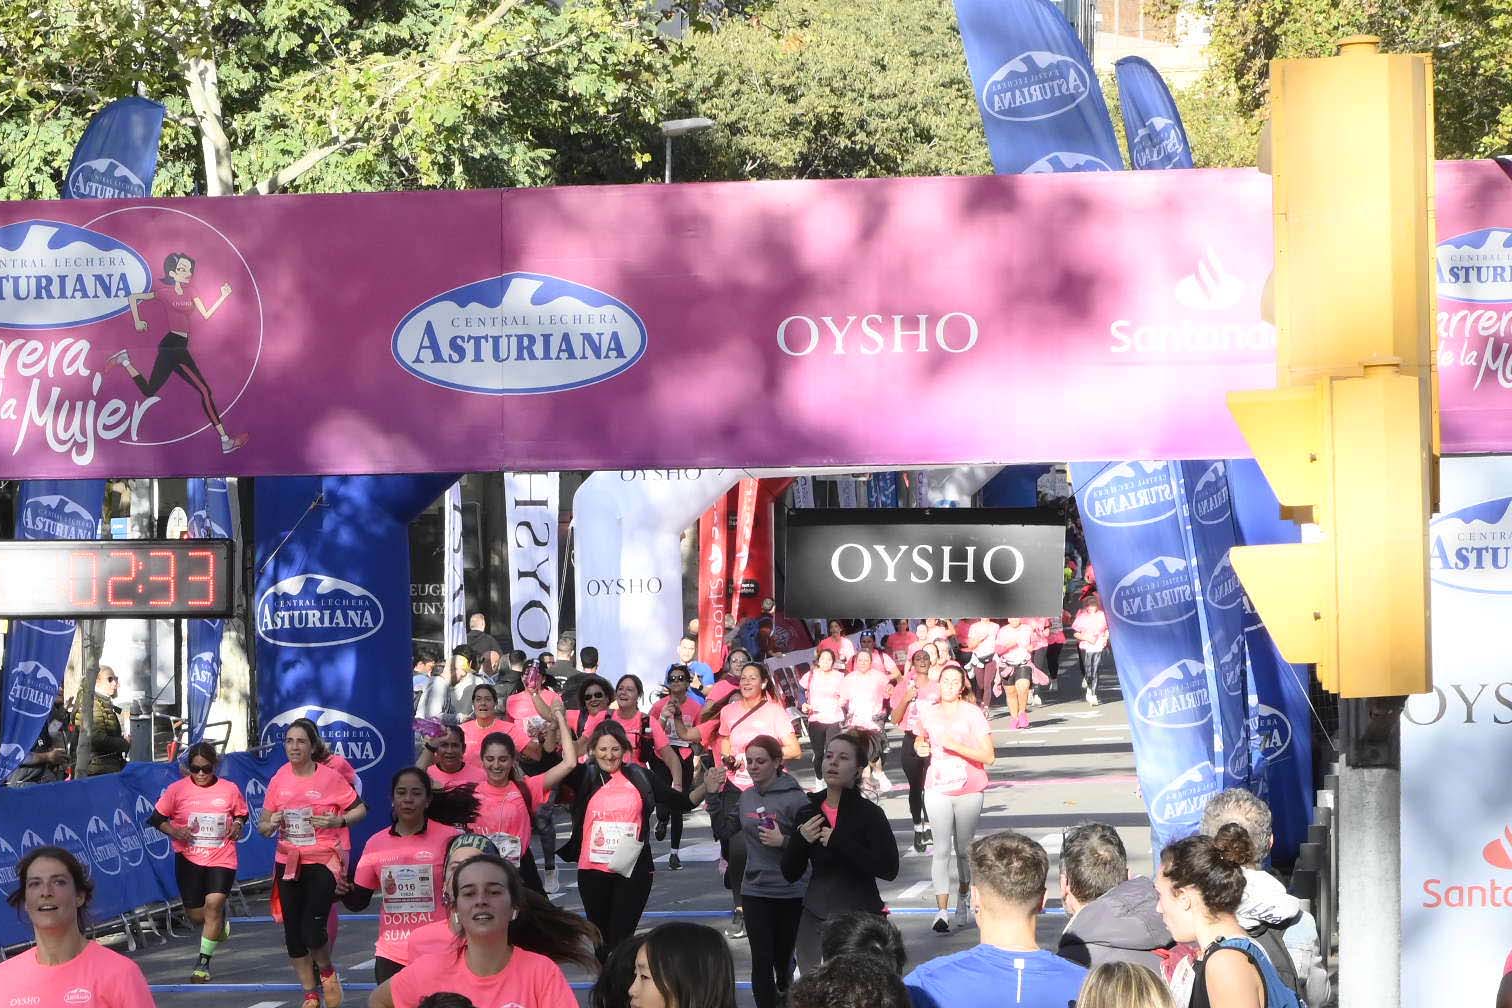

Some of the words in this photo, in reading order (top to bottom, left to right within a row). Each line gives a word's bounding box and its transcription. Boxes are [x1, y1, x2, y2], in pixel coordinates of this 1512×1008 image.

[54, 255, 127, 268] LECHERA
[451, 315, 529, 329] CENTRAL
[537, 312, 619, 326] LECHERA
[412, 319, 627, 364] ASTURIANA
[777, 311, 979, 357] OYSHO
[12, 372, 162, 467] Mujer
[514, 473, 552, 650] OYSH
[830, 542, 1026, 585] OYSHO
[586, 576, 663, 597] OYSHO
[261, 603, 375, 631] ASTURIANA
[397, 883, 416, 891] 016
[383, 912, 434, 925] DORSAL
[384, 929, 411, 941] SUM
